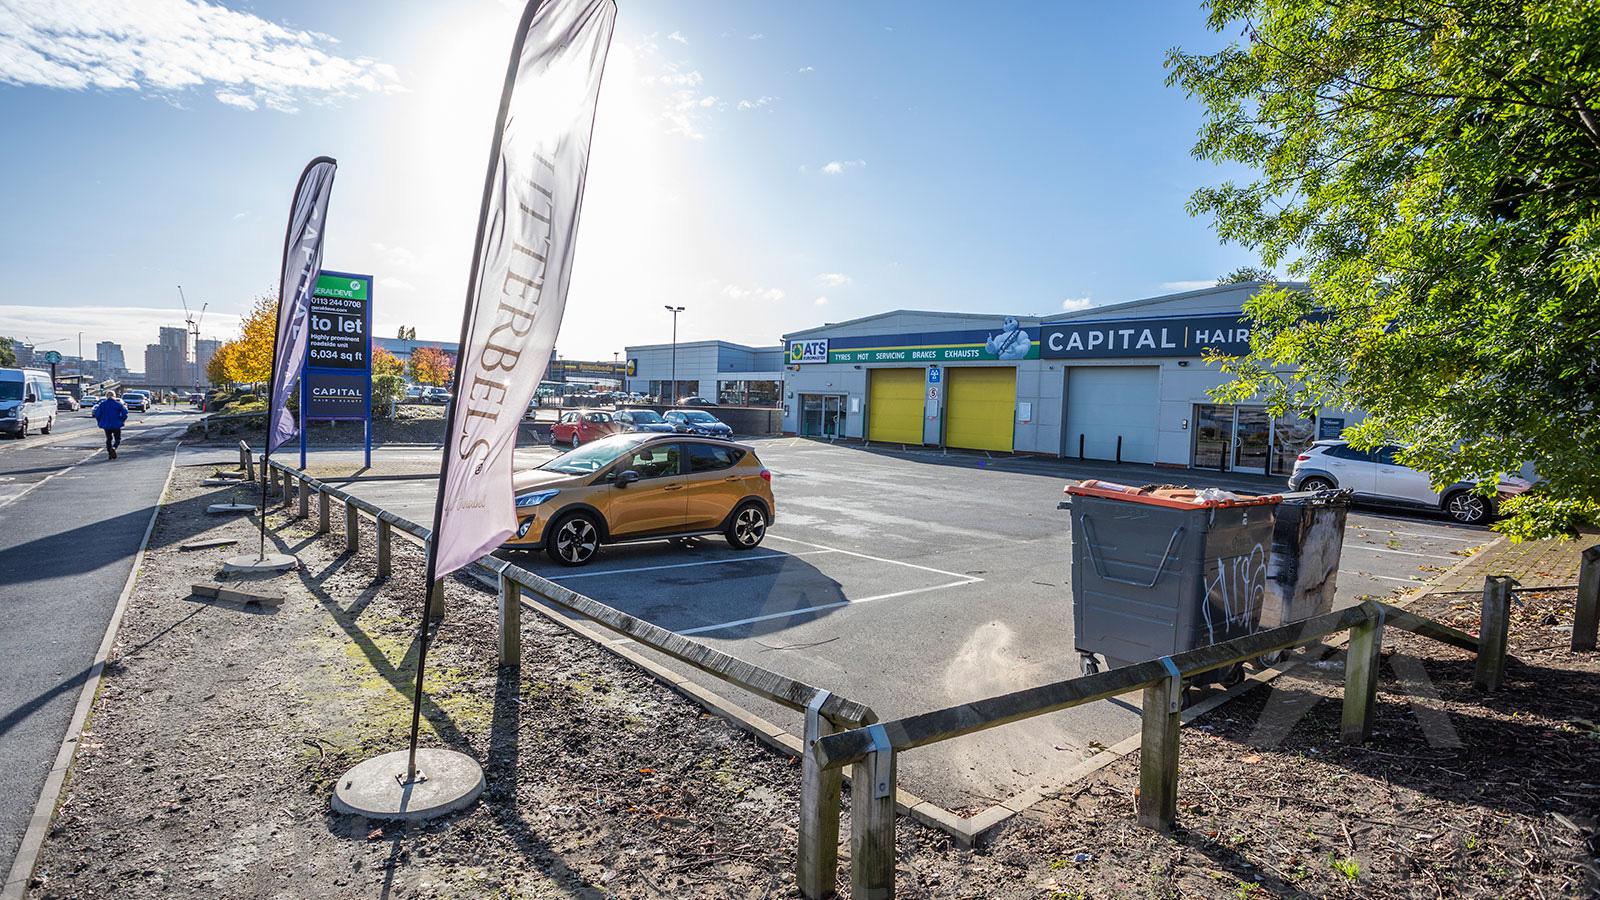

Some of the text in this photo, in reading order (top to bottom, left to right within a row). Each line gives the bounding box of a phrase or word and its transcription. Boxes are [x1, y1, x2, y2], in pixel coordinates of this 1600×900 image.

[311, 297, 328, 305] 0113
[343, 300, 362, 309] 0708
[311, 315, 363, 333] to let
[1048, 328, 1250, 351] CAPITAL HAIR
[804, 342, 826, 355] ATS
[310, 349, 363, 361] 6,034 sq ft
[835, 349, 980, 361] TYRES MOT SERVICING BRAKES EXHAUSTS
[312, 387, 363, 396] CAPITAL
